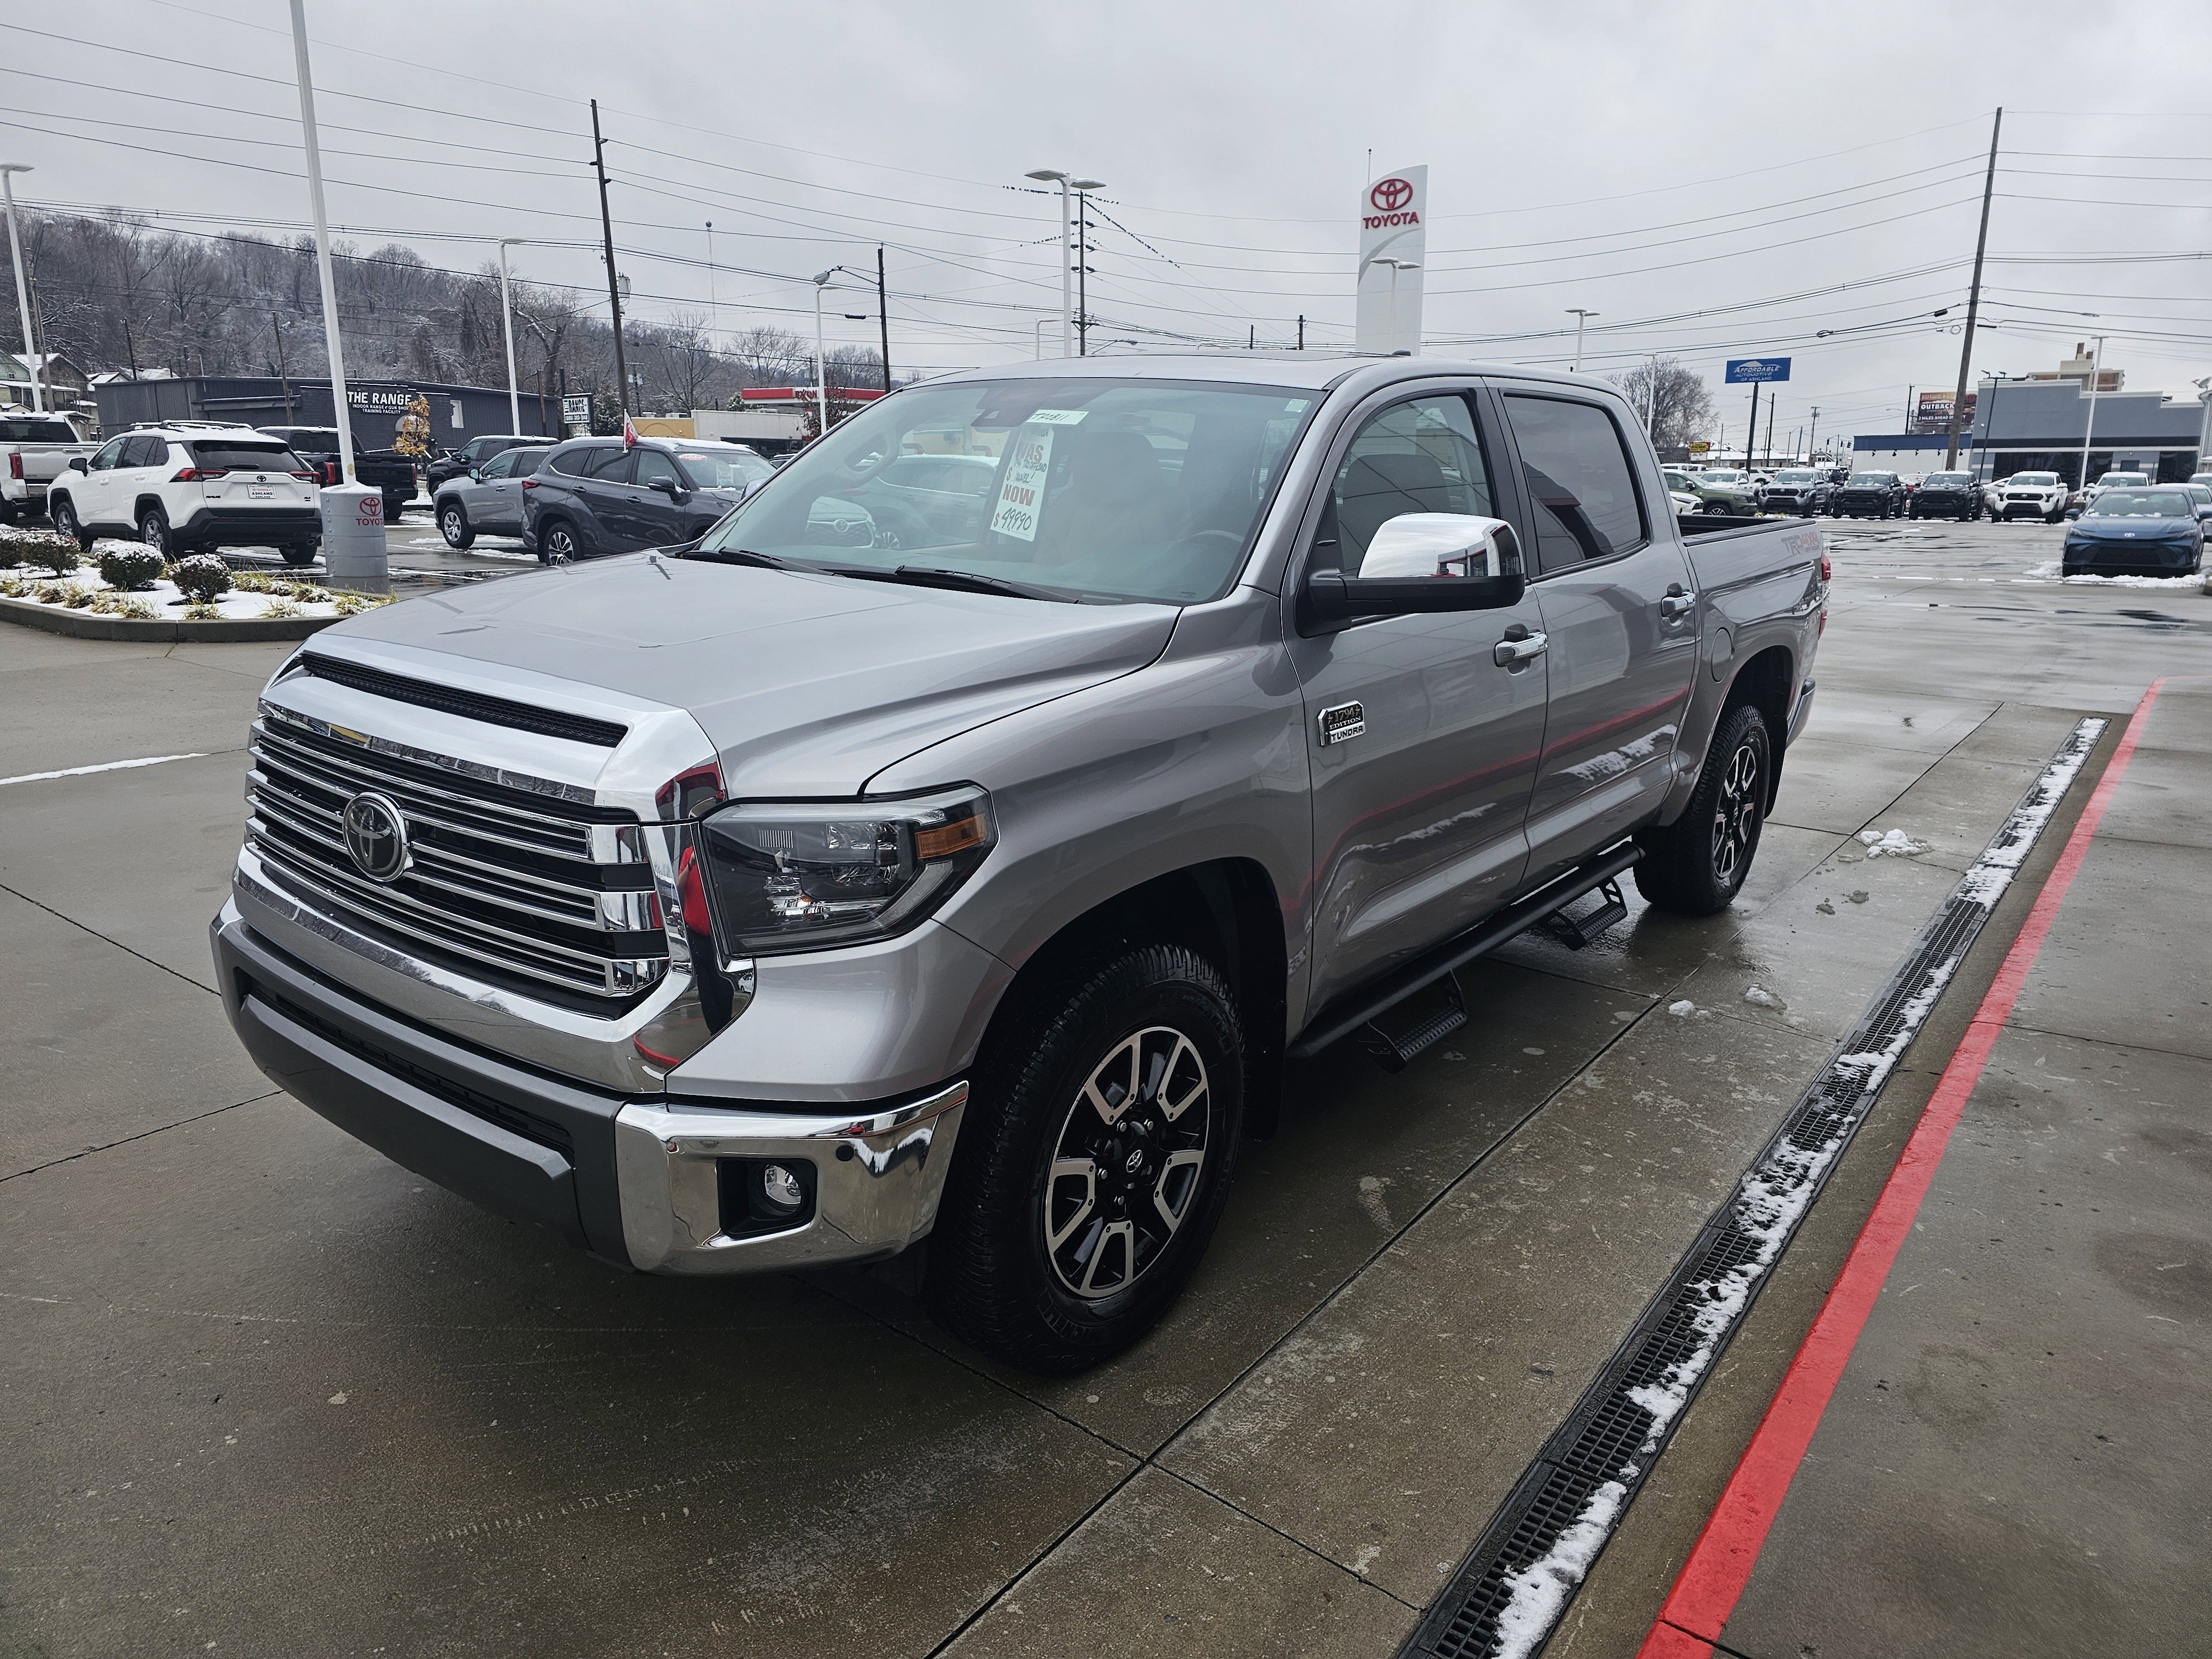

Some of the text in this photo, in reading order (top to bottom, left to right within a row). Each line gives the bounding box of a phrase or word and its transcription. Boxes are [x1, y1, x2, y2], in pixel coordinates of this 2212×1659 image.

[1363, 212, 1419, 229] TOYOTA
[347, 392, 411, 405] THE RANGE
[568, 399, 585, 413] RANGE
[1015, 442, 1044, 462] WAS
[1006, 466, 1013, 481] $
[1003, 484, 1036, 507] NOW
[994, 507, 1032, 531] $ 49,990
[1781, 535, 1803, 556] TRD
[1334, 707, 1355, 722] 1794
[1329, 716, 1361, 729] EDITION
[1331, 725, 1363, 740] TUNDRA
